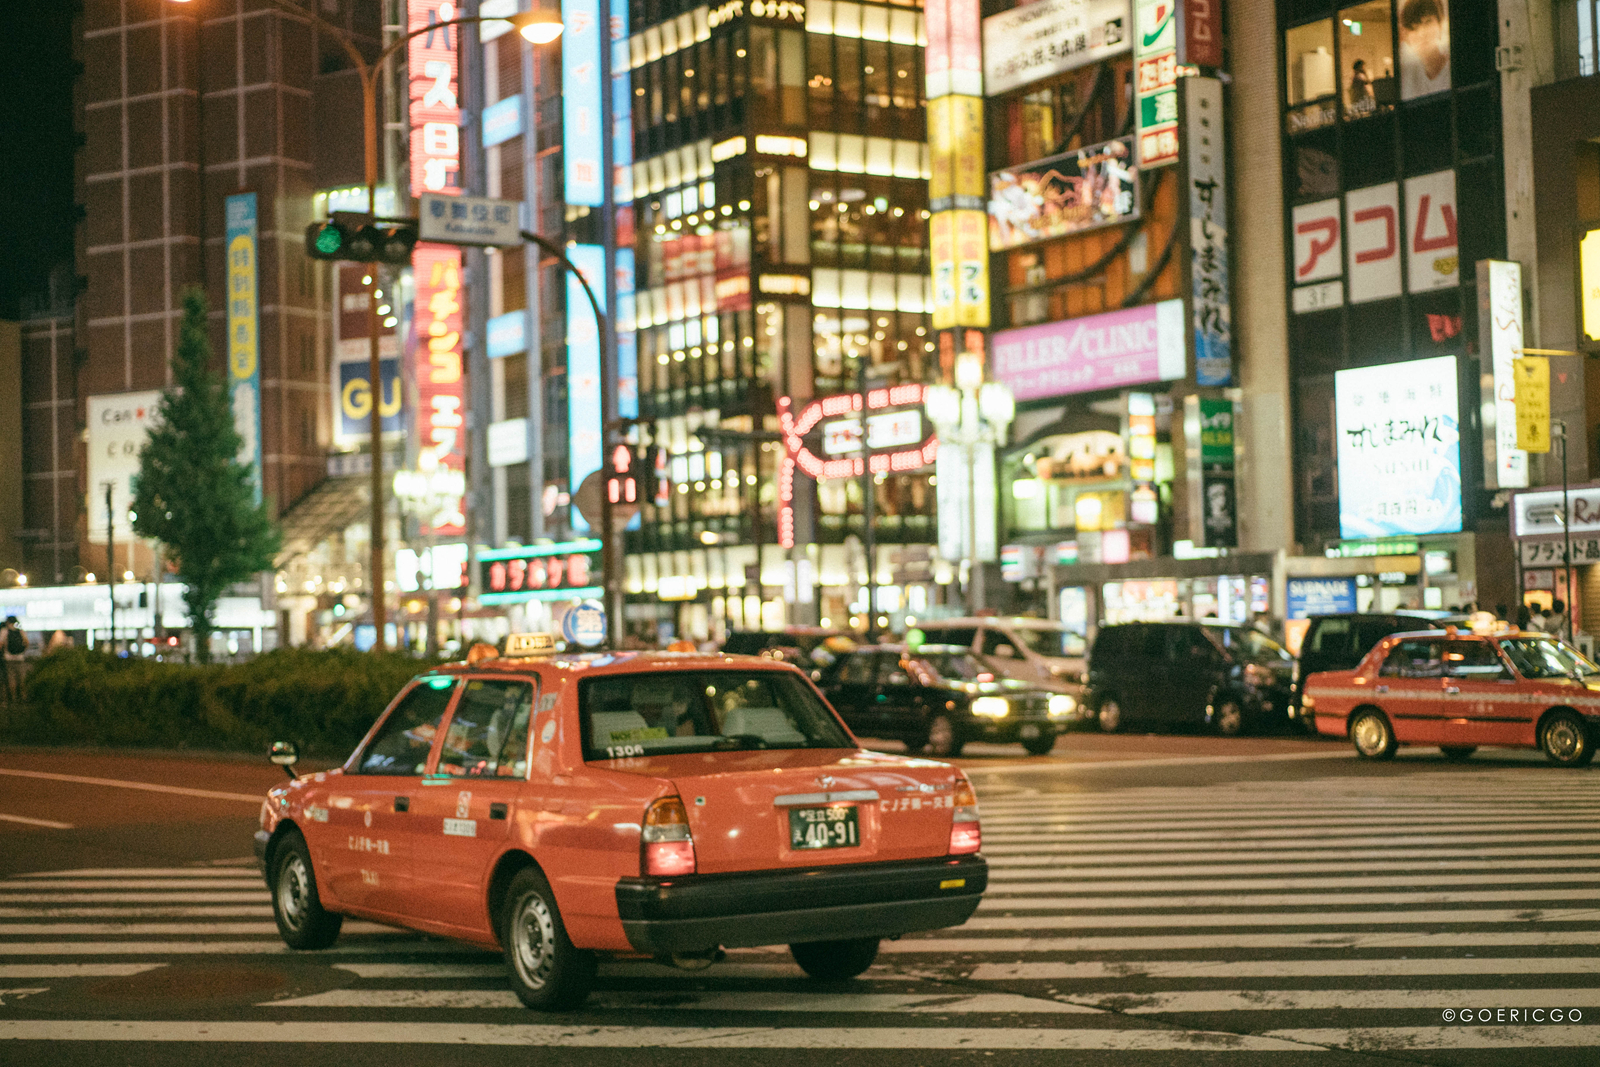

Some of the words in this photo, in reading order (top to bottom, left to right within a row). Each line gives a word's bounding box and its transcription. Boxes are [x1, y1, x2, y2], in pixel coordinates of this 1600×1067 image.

[1297, 193, 1459, 278] アコム
[429, 257, 462, 385] パチンコ
[342, 376, 402, 420] GU
[606, 744, 644, 757] 1306
[805, 821, 855, 846] 40-91
